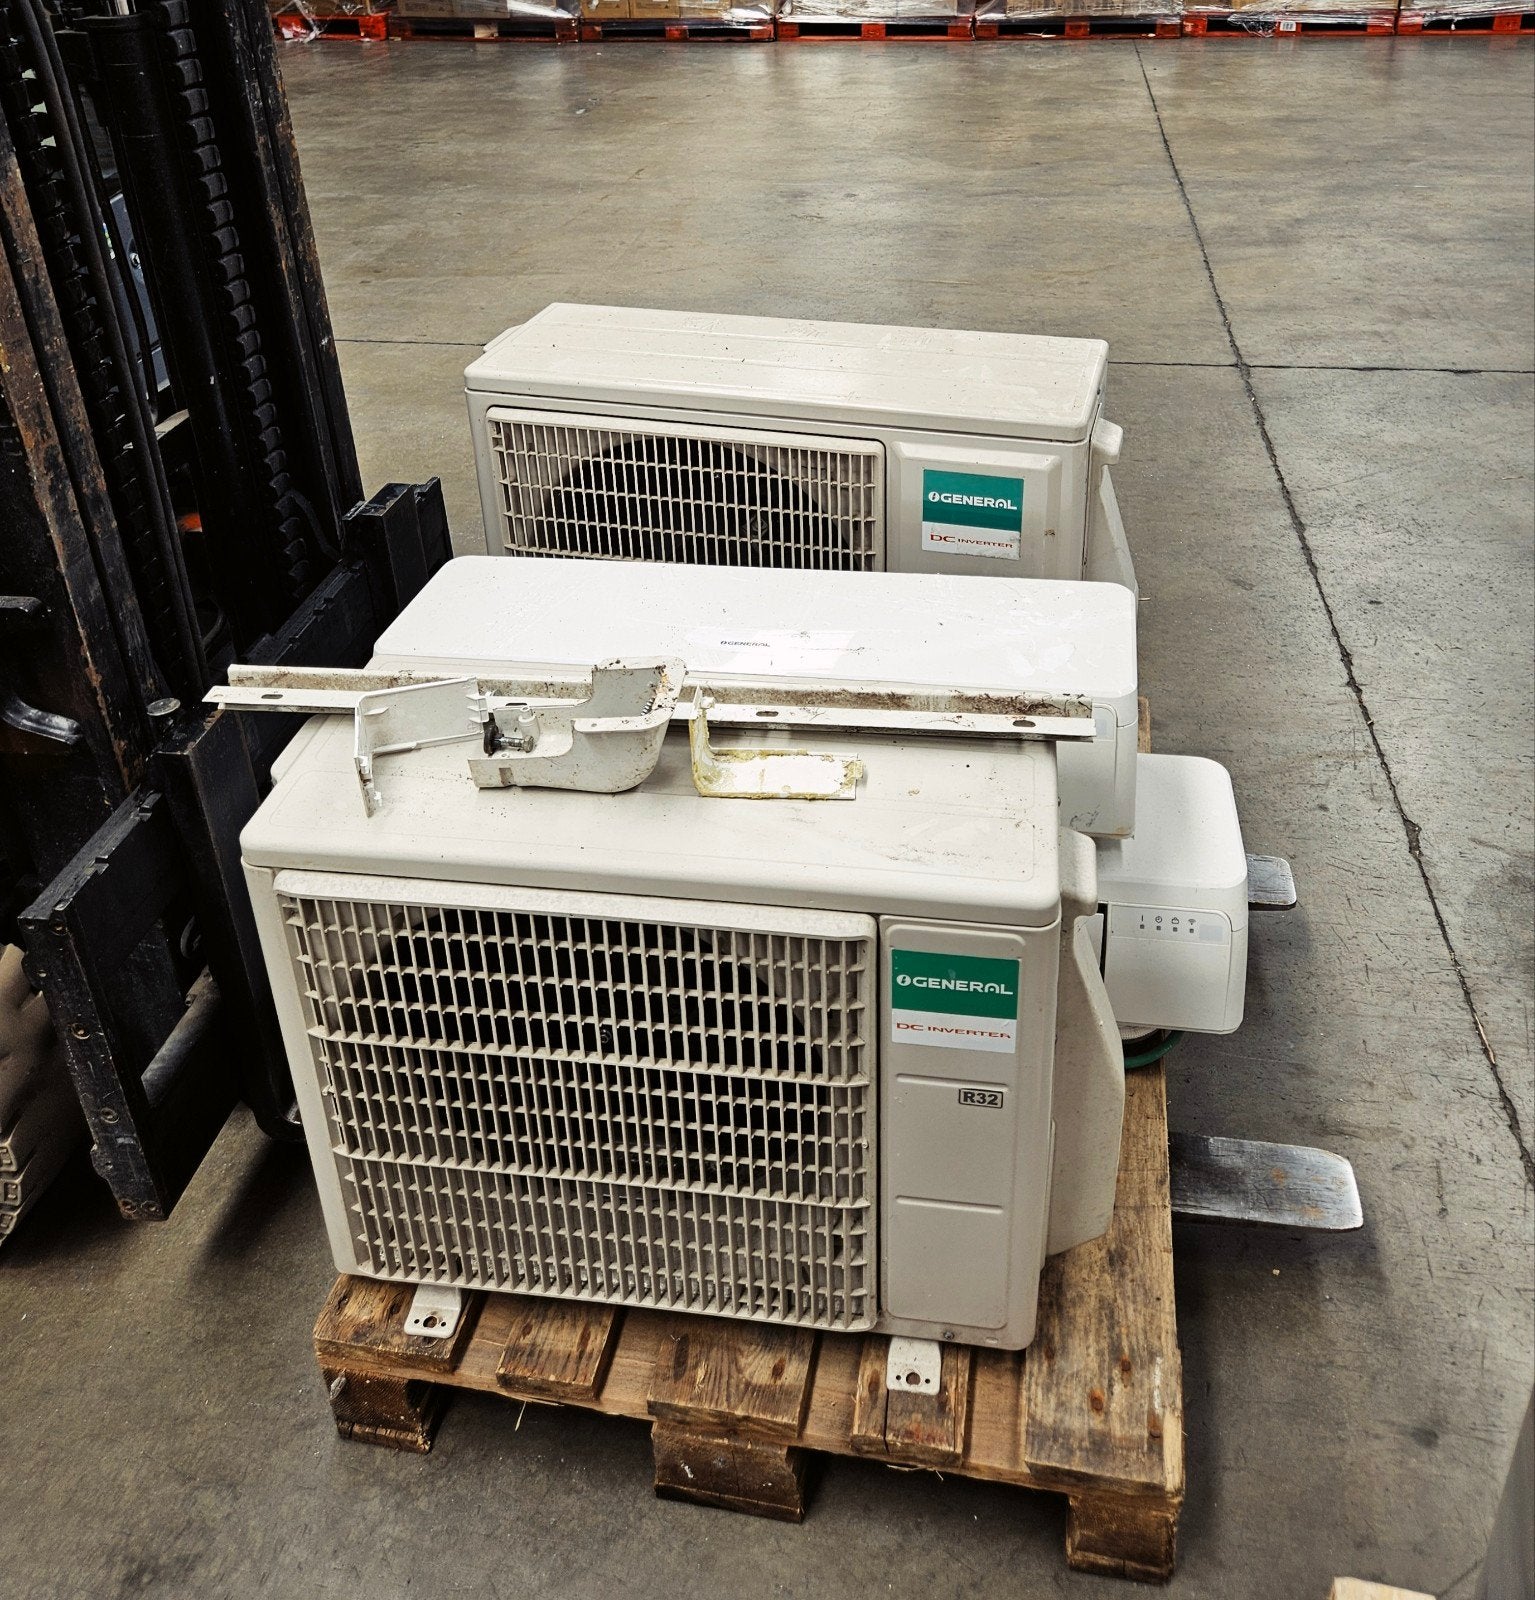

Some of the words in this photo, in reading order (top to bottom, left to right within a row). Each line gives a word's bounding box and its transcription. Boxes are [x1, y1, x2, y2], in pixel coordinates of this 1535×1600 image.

[940, 493, 1018, 510] GENERAL
[930, 534, 956, 543] DC
[957, 538, 1014, 549] INVERTER
[912, 976, 1014, 995] GENERAL
[896, 1022, 924, 1032] DC
[927, 1025, 1012, 1039] INVERTER
[963, 1090, 999, 1106] R32
